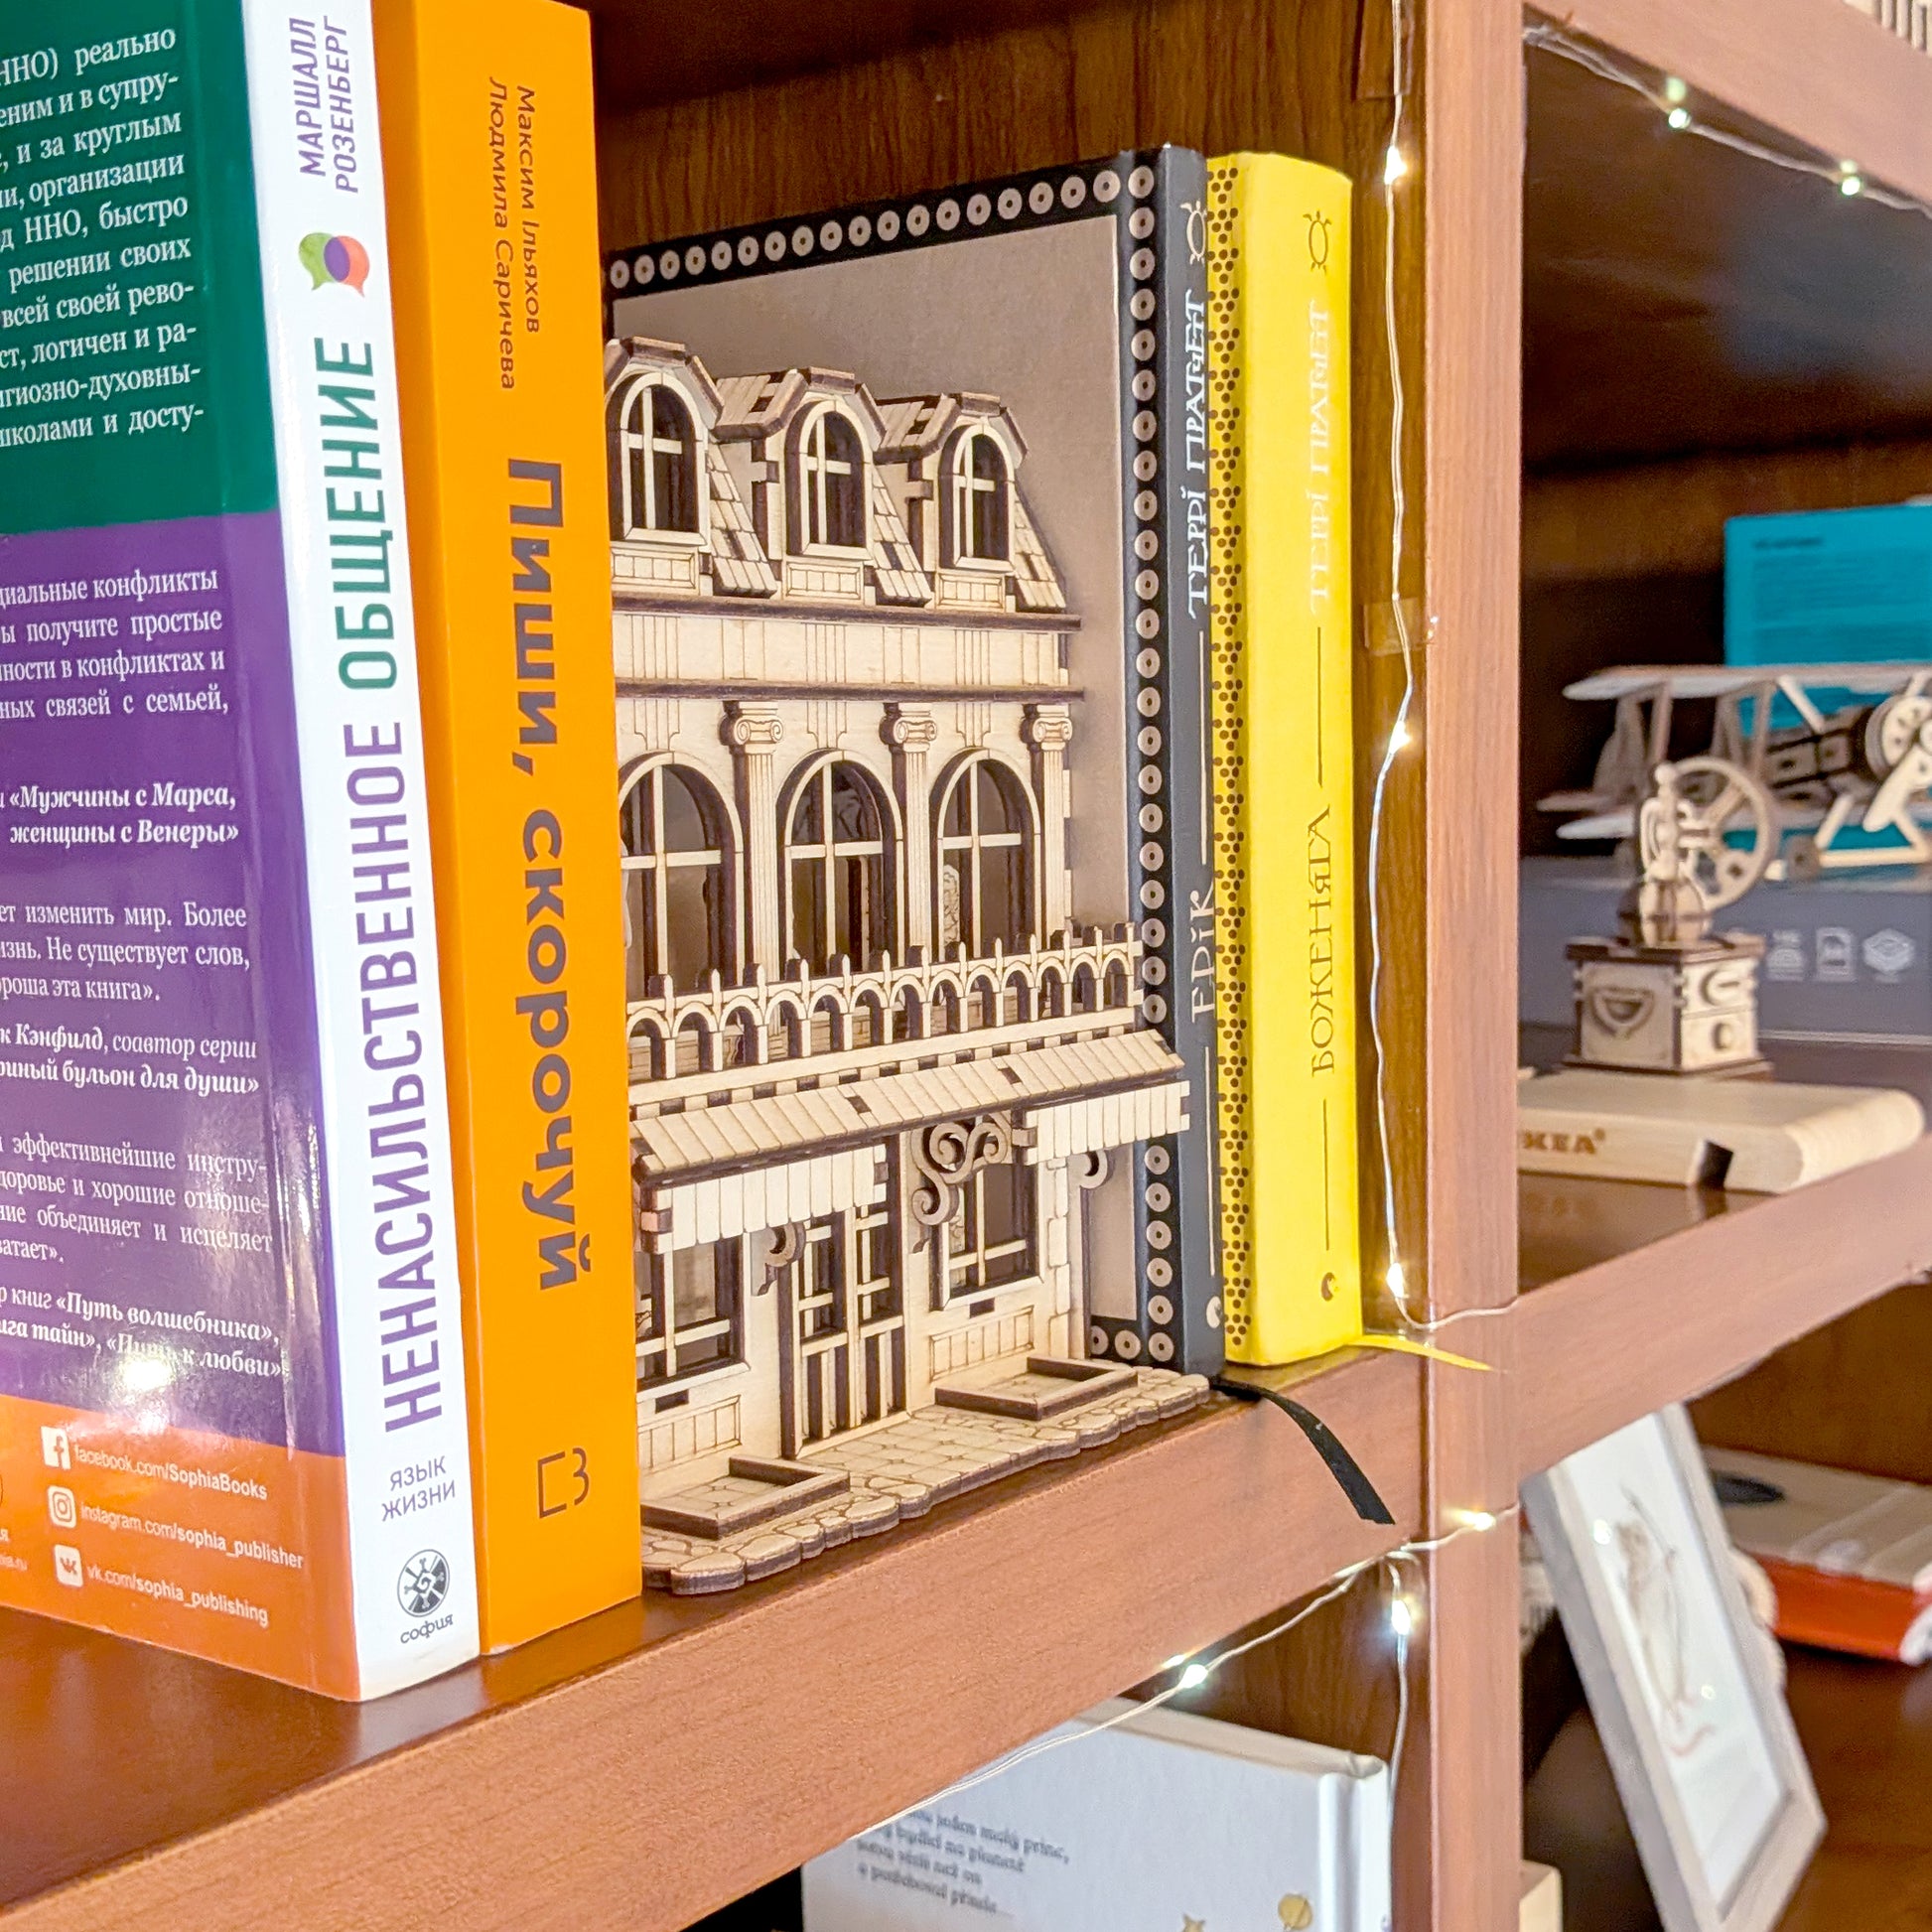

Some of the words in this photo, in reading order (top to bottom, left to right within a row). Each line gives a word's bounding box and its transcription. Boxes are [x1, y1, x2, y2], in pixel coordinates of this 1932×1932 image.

[74, 28, 176, 75] реально
[59, 92, 74, 114] и
[79, 89, 93, 109] в
[99, 70, 179, 110] супру-
[289, 18, 326, 177] МАРШАЛЛ
[324, 15, 358, 194] РОЗЕНБЕРГ
[17, 143, 32, 165] и
[40, 136, 65, 160] за
[73, 112, 182, 156] круглым
[489, 76, 508, 229] Людмила
[516, 85, 536, 209] Максим
[29, 153, 185, 207] организации
[24, 207, 88, 245] ННО,
[99, 197, 189, 230] быстро
[8, 250, 110, 293] решении
[120, 237, 192, 267] своих
[522, 219, 540, 334] Ільяхов
[1, 295, 50, 329] всей
[56, 283, 121, 319] своей
[127, 281, 195, 316] рево-
[492, 239, 515, 389] Саричева
[31, 331, 127, 364] логичен
[134, 328, 150, 347] и
[157, 322, 198, 352] ра-
[102, 414, 118, 434] и
[128, 404, 205, 435] досту-
[314, 337, 397, 690] ОБЩЕНИЕ
[93, 569, 218, 603] конфликты
[27, 617, 119, 646] получите
[130, 609, 222, 642] простые
[507, 458, 564, 776] Пиши,
[62, 658, 72, 677] в
[76, 649, 206, 681] конфликтах
[210, 650, 225, 670] и
[46, 688, 111, 718] связей
[122, 694, 134, 714] с
[146, 683, 229, 715] семьей,
[9, 784, 131, 814] «Мужчины
[135, 788, 148, 807] с
[151, 781, 237, 813] Марса,
[10, 823, 116, 850] женщины
[120, 824, 133, 843] с
[137, 819, 239, 849] Венеры»
[25, 904, 114, 925] изменить
[124, 906, 173, 932] мир.
[183, 901, 247, 927] Более
[1308, 804, 1334, 1077] БОЖЕНЯТА
[47, 936, 72, 961] Не
[77, 942, 189, 970] существует
[195, 946, 250, 971] слов,
[0, 977, 50, 1000] роша
[53, 979, 81, 998] эта
[85, 981, 161, 1002] книга».
[15, 1024, 109, 1054] Кэнфилд,
[112, 1035, 196, 1062] соавтор
[200, 1039, 257, 1063] серии
[515, 809, 592, 1291] скорочуй
[63, 1060, 136, 1088] бульон
[140, 1063, 180, 1090] для
[184, 1066, 259, 1097] души»
[344, 722, 443, 1433] НЕНАСИЛЬСТВЕННОЕ
[13, 1132, 176, 1170] эффективнейшие
[187, 1153, 267, 1182] инстру-
[1522, 1129, 1595, 1155] KEA
[72, 1178, 84, 1197] и
[91, 1180, 176, 1207] хорошие
[184, 1190, 270, 1214] отноше-
[37, 1204, 141, 1238] объединяет
[154, 1223, 167, 1241] и
[181, 1226, 273, 1254] исцеляет
[12, 1289, 52, 1310] книг
[57, 1291, 123, 1321] «Путь
[127, 1310, 280, 1347] волшебника»,
[32, 1323, 102, 1354] тайн»,
[183, 1348, 195, 1365] к
[74, 1444, 268, 1500] facebook.com/SophiaBooks
[389, 1455, 447, 1491] ЯЗЫК
[381, 1479, 456, 1522] ЖИЗНИ
[80, 1501, 304, 1569] instagram.com/sophia_publisher
[86, 1564, 269, 1628] vk.com/sophia_publishing
[400, 1613, 454, 1644] софия
